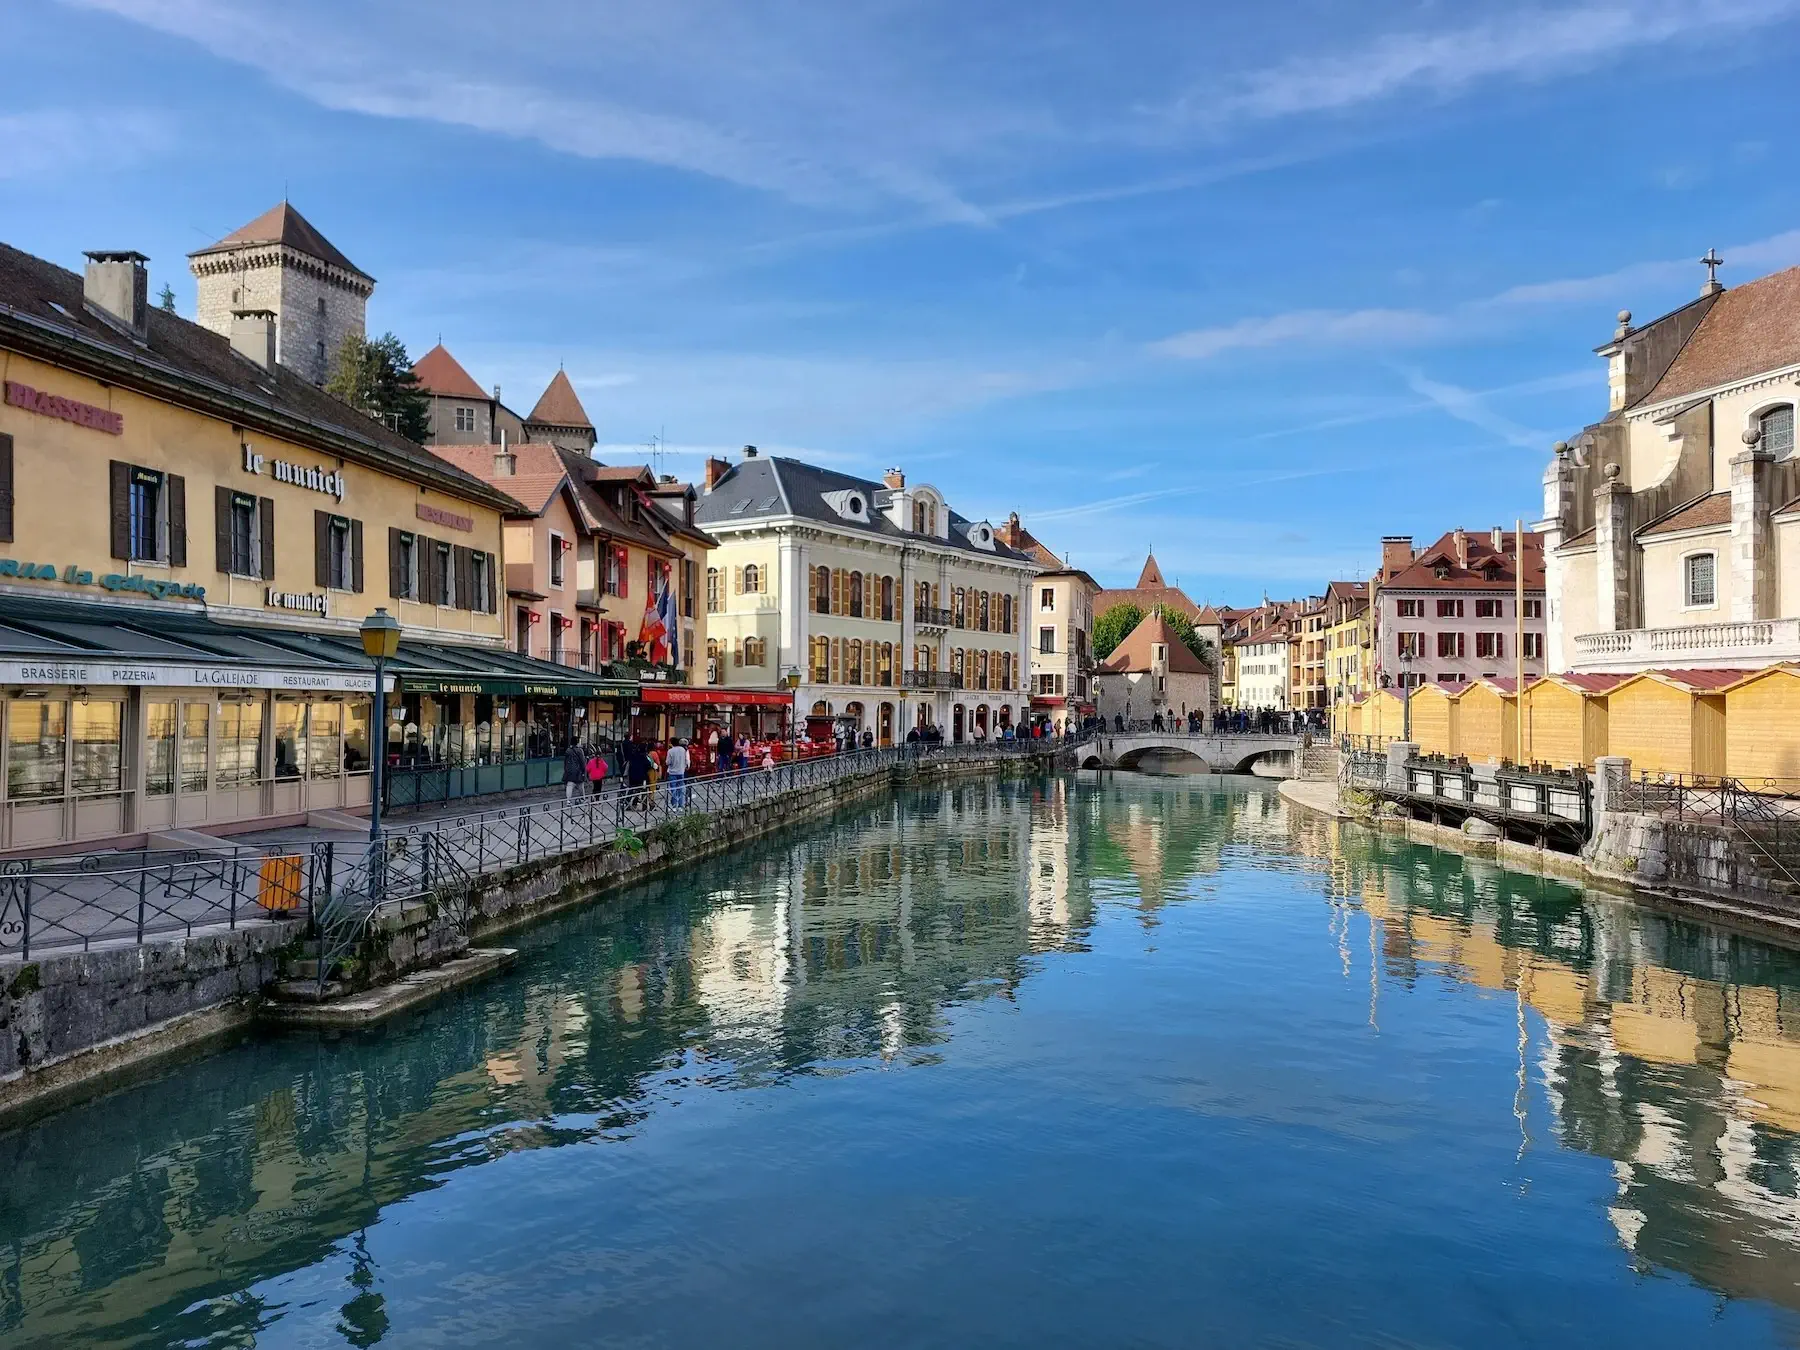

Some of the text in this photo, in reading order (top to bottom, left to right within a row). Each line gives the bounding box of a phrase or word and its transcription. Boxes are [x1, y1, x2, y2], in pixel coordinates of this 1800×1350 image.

[4, 381, 123, 435] BRASSERIE
[242, 444, 344, 504] le munich
[265, 587, 329, 617] le munich
[21, 668, 372, 688] BRASSERIE PIZZERIA LA GALEJADE RESTAURANT GLACIER
[440, 683, 481, 693] le munich
